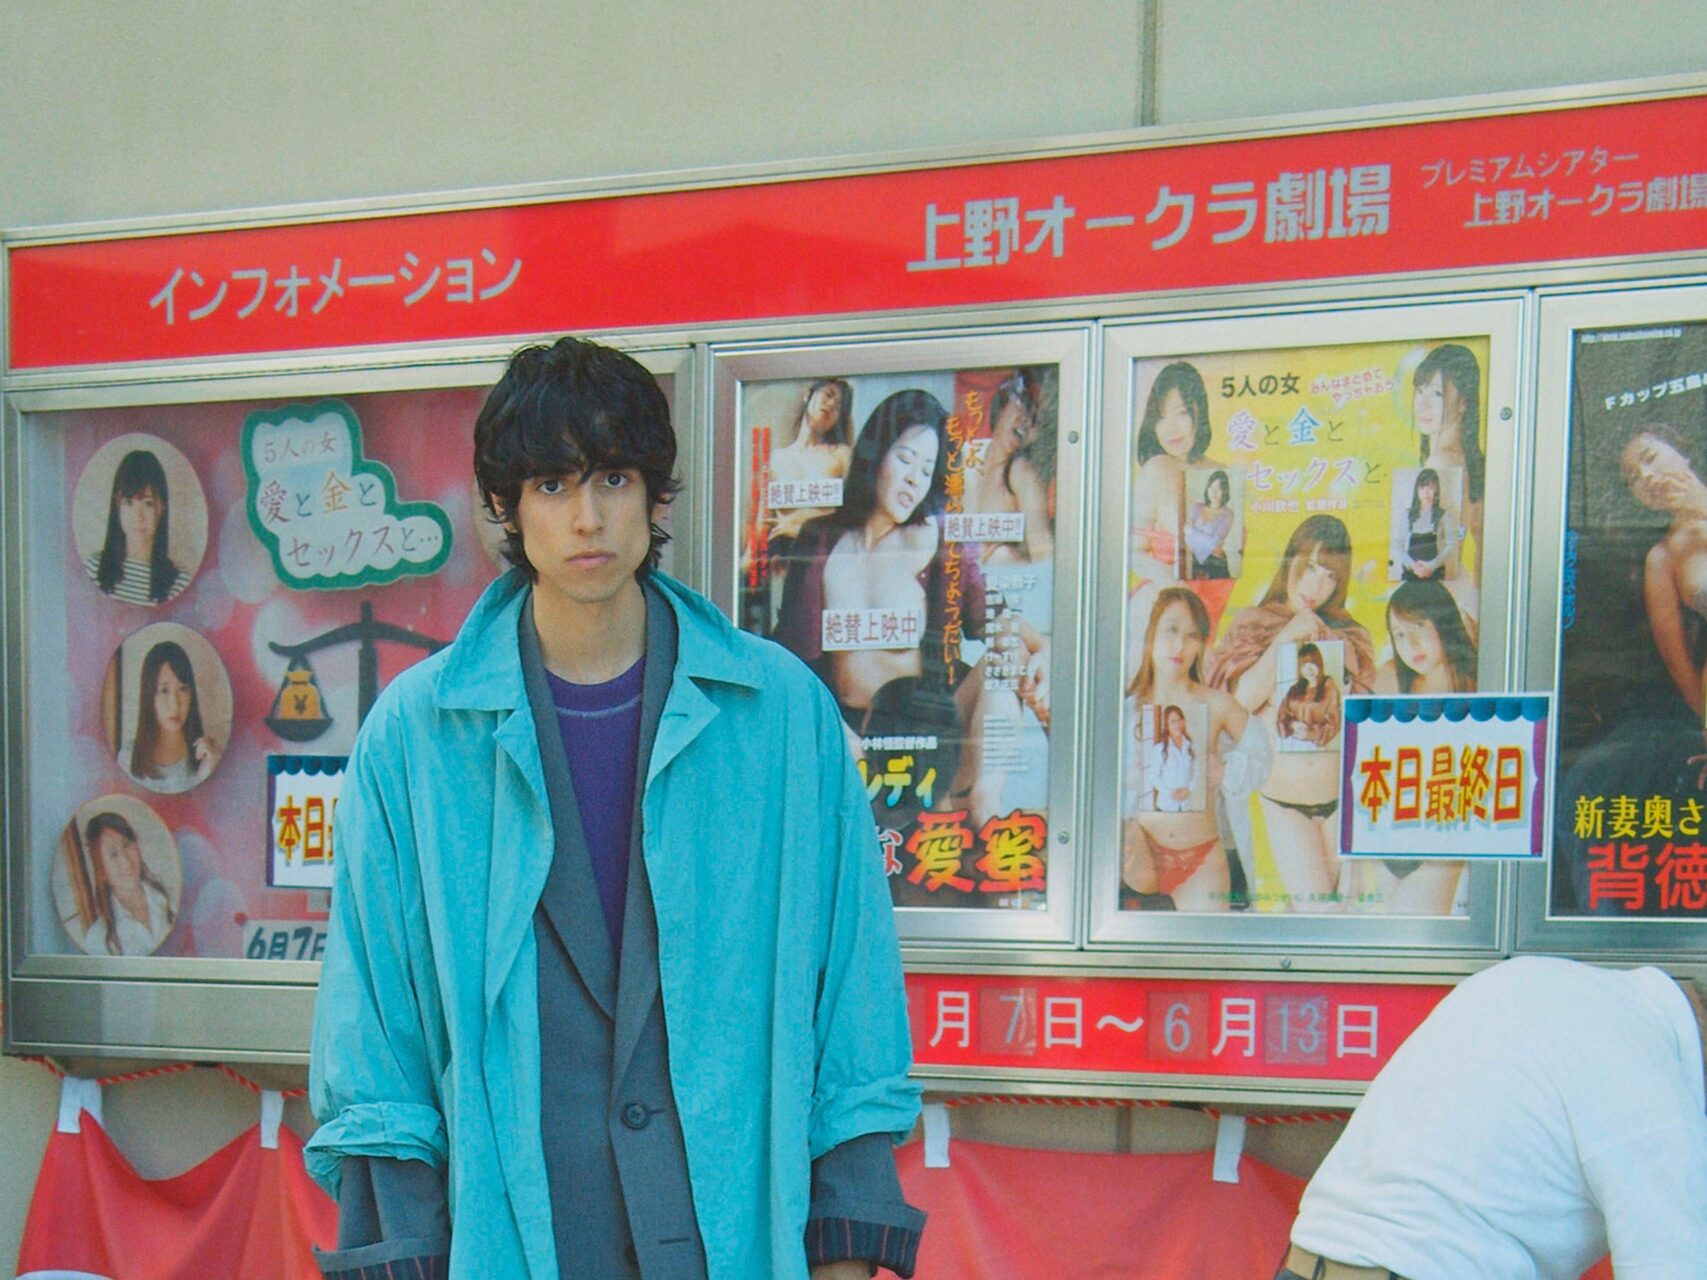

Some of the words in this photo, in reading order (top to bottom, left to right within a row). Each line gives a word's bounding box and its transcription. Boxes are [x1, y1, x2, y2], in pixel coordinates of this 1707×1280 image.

[1421, 146, 1639, 189] プレミアムシアター
[905, 163, 1391, 273] 上野オークラ劇場
[1463, 173, 1707, 228] 上野オークラ劇場
[149, 247, 522, 325] インフォメーション
[1222, 372, 1302, 398] 5人の女
[264, 432, 338, 463] 5人の女
[1228, 406, 1344, 450] 愛と金と
[260, 469, 377, 525] 愛と金と
[1360, 744, 1525, 825] 本日最終日
[277, 794, 336, 861] 本日
[1574, 795, 1705, 839] 新妻奥さ
[1586, 842, 1707, 911] 背徳
